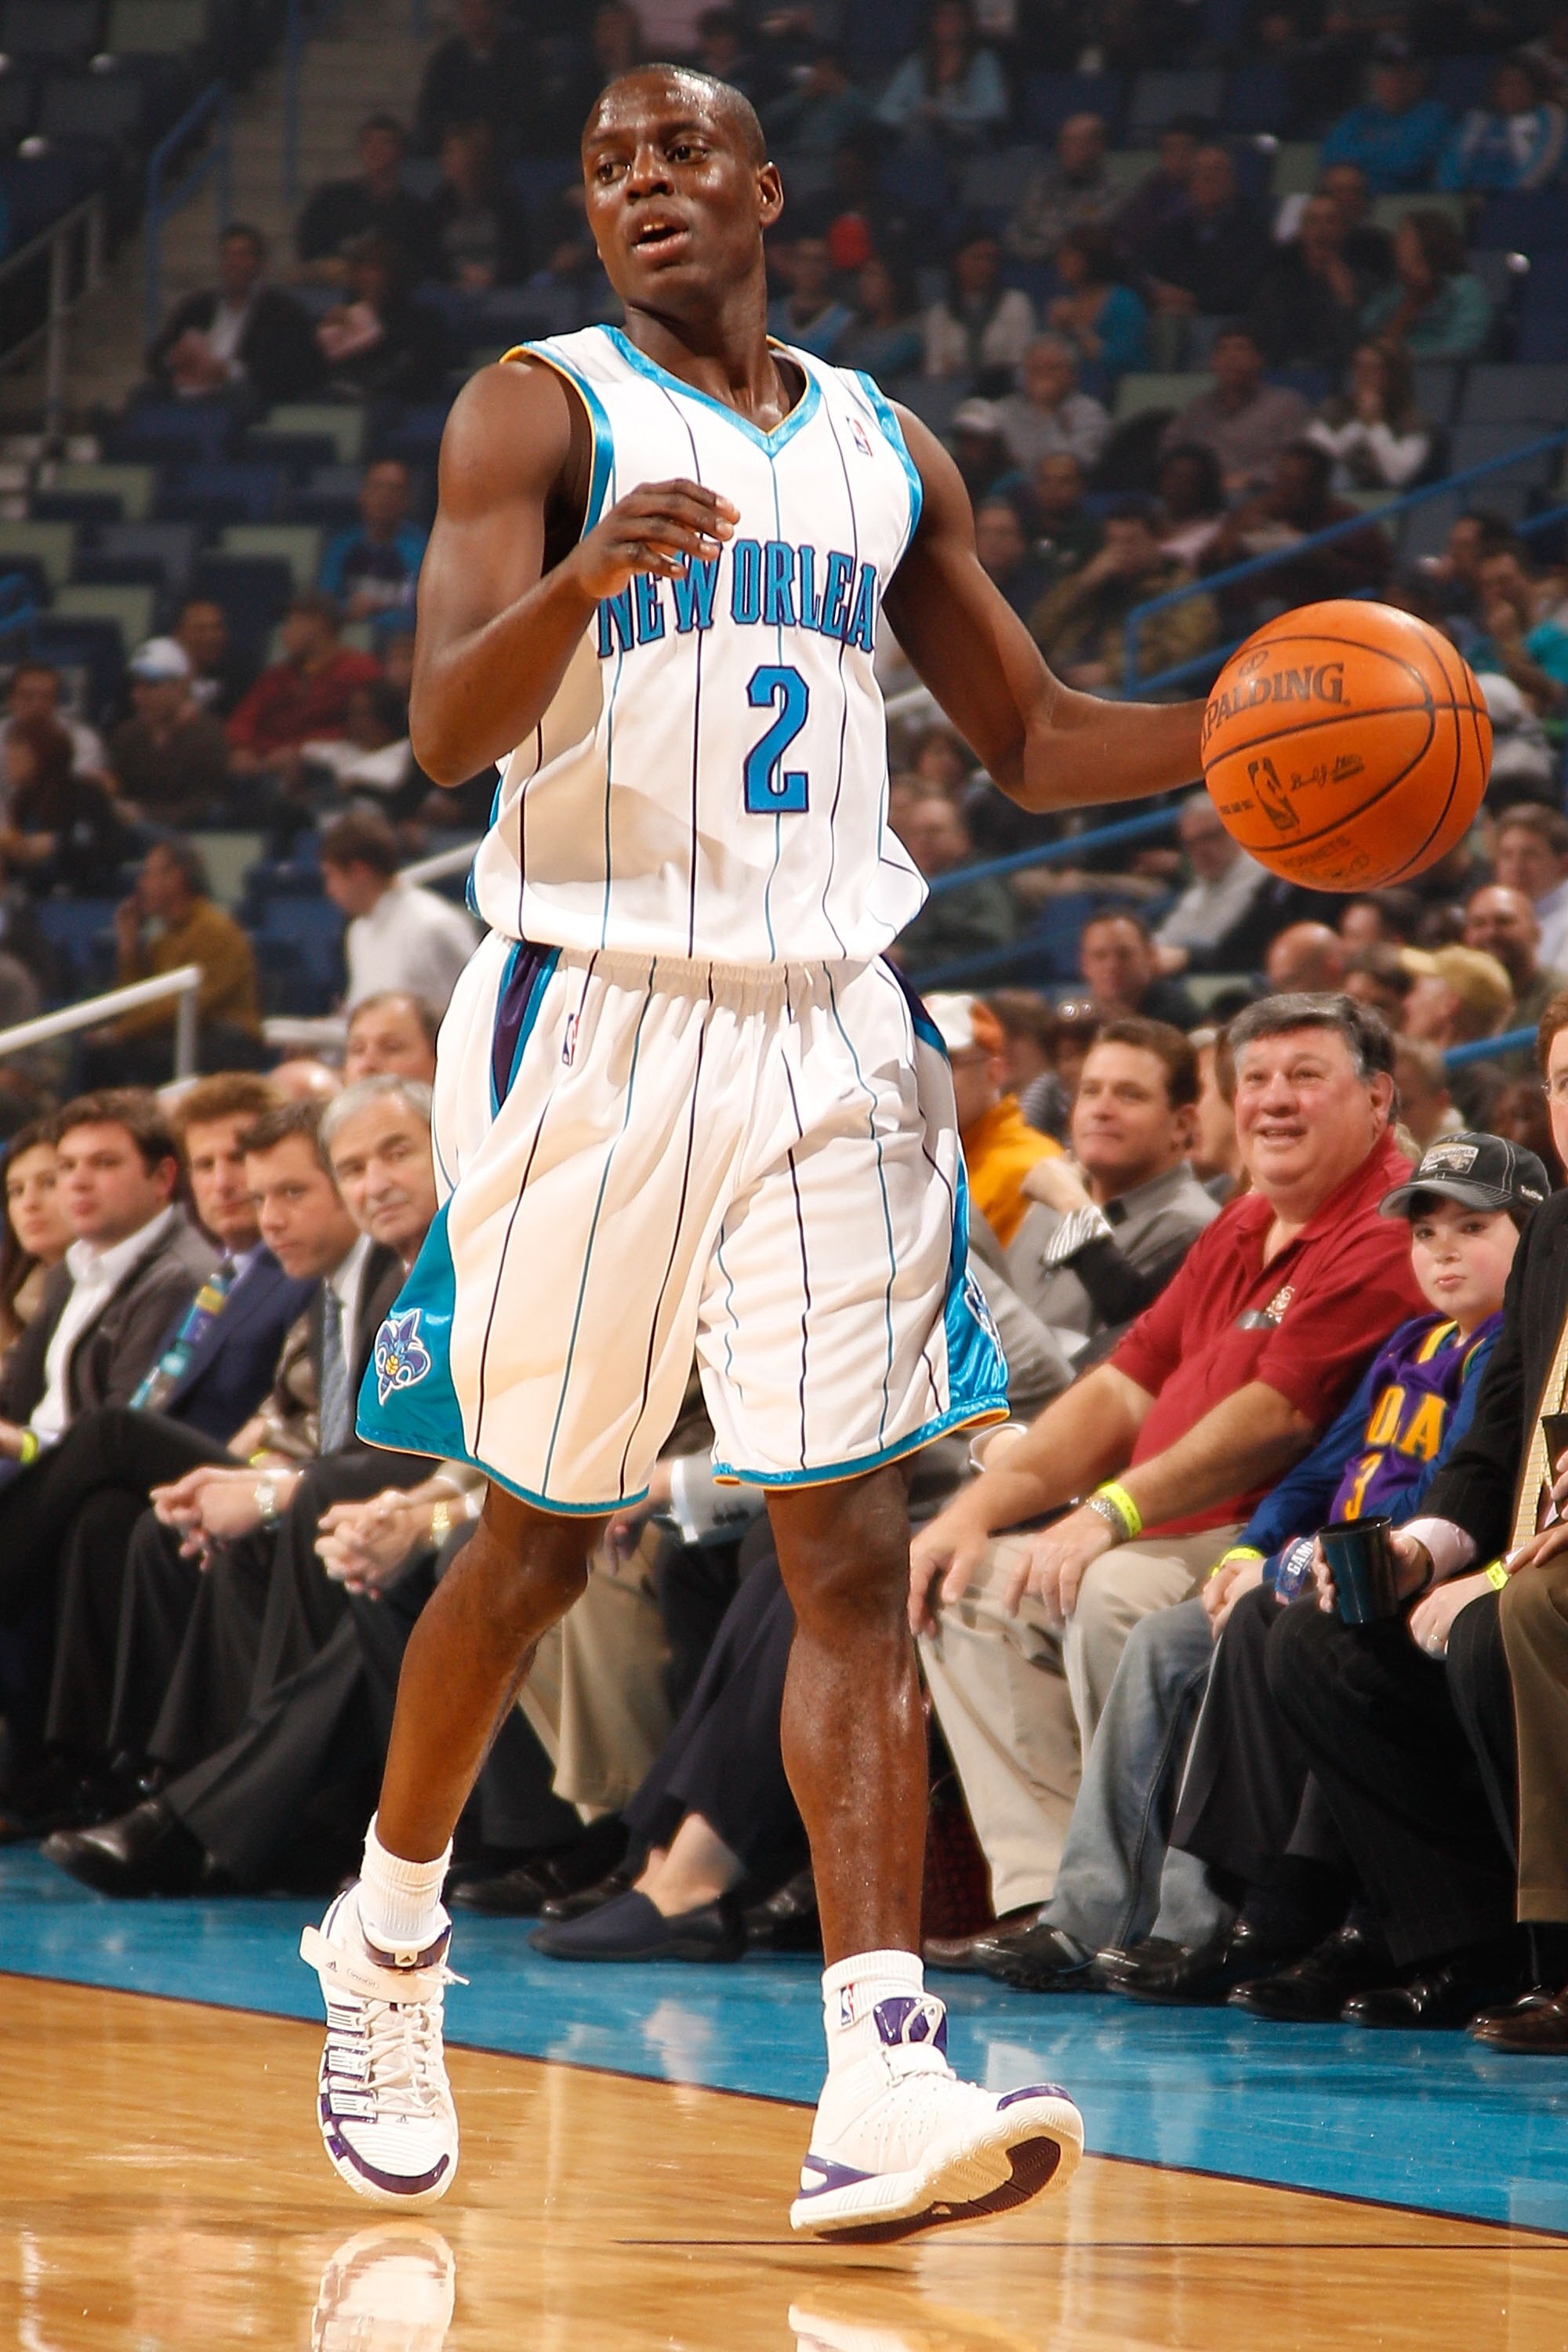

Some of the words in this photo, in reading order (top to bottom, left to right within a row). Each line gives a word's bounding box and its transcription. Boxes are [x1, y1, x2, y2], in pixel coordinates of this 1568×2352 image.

[597, 541, 724, 659] NEW
[730, 539, 880, 653] ORLEA
[743, 665, 810, 814] 2
